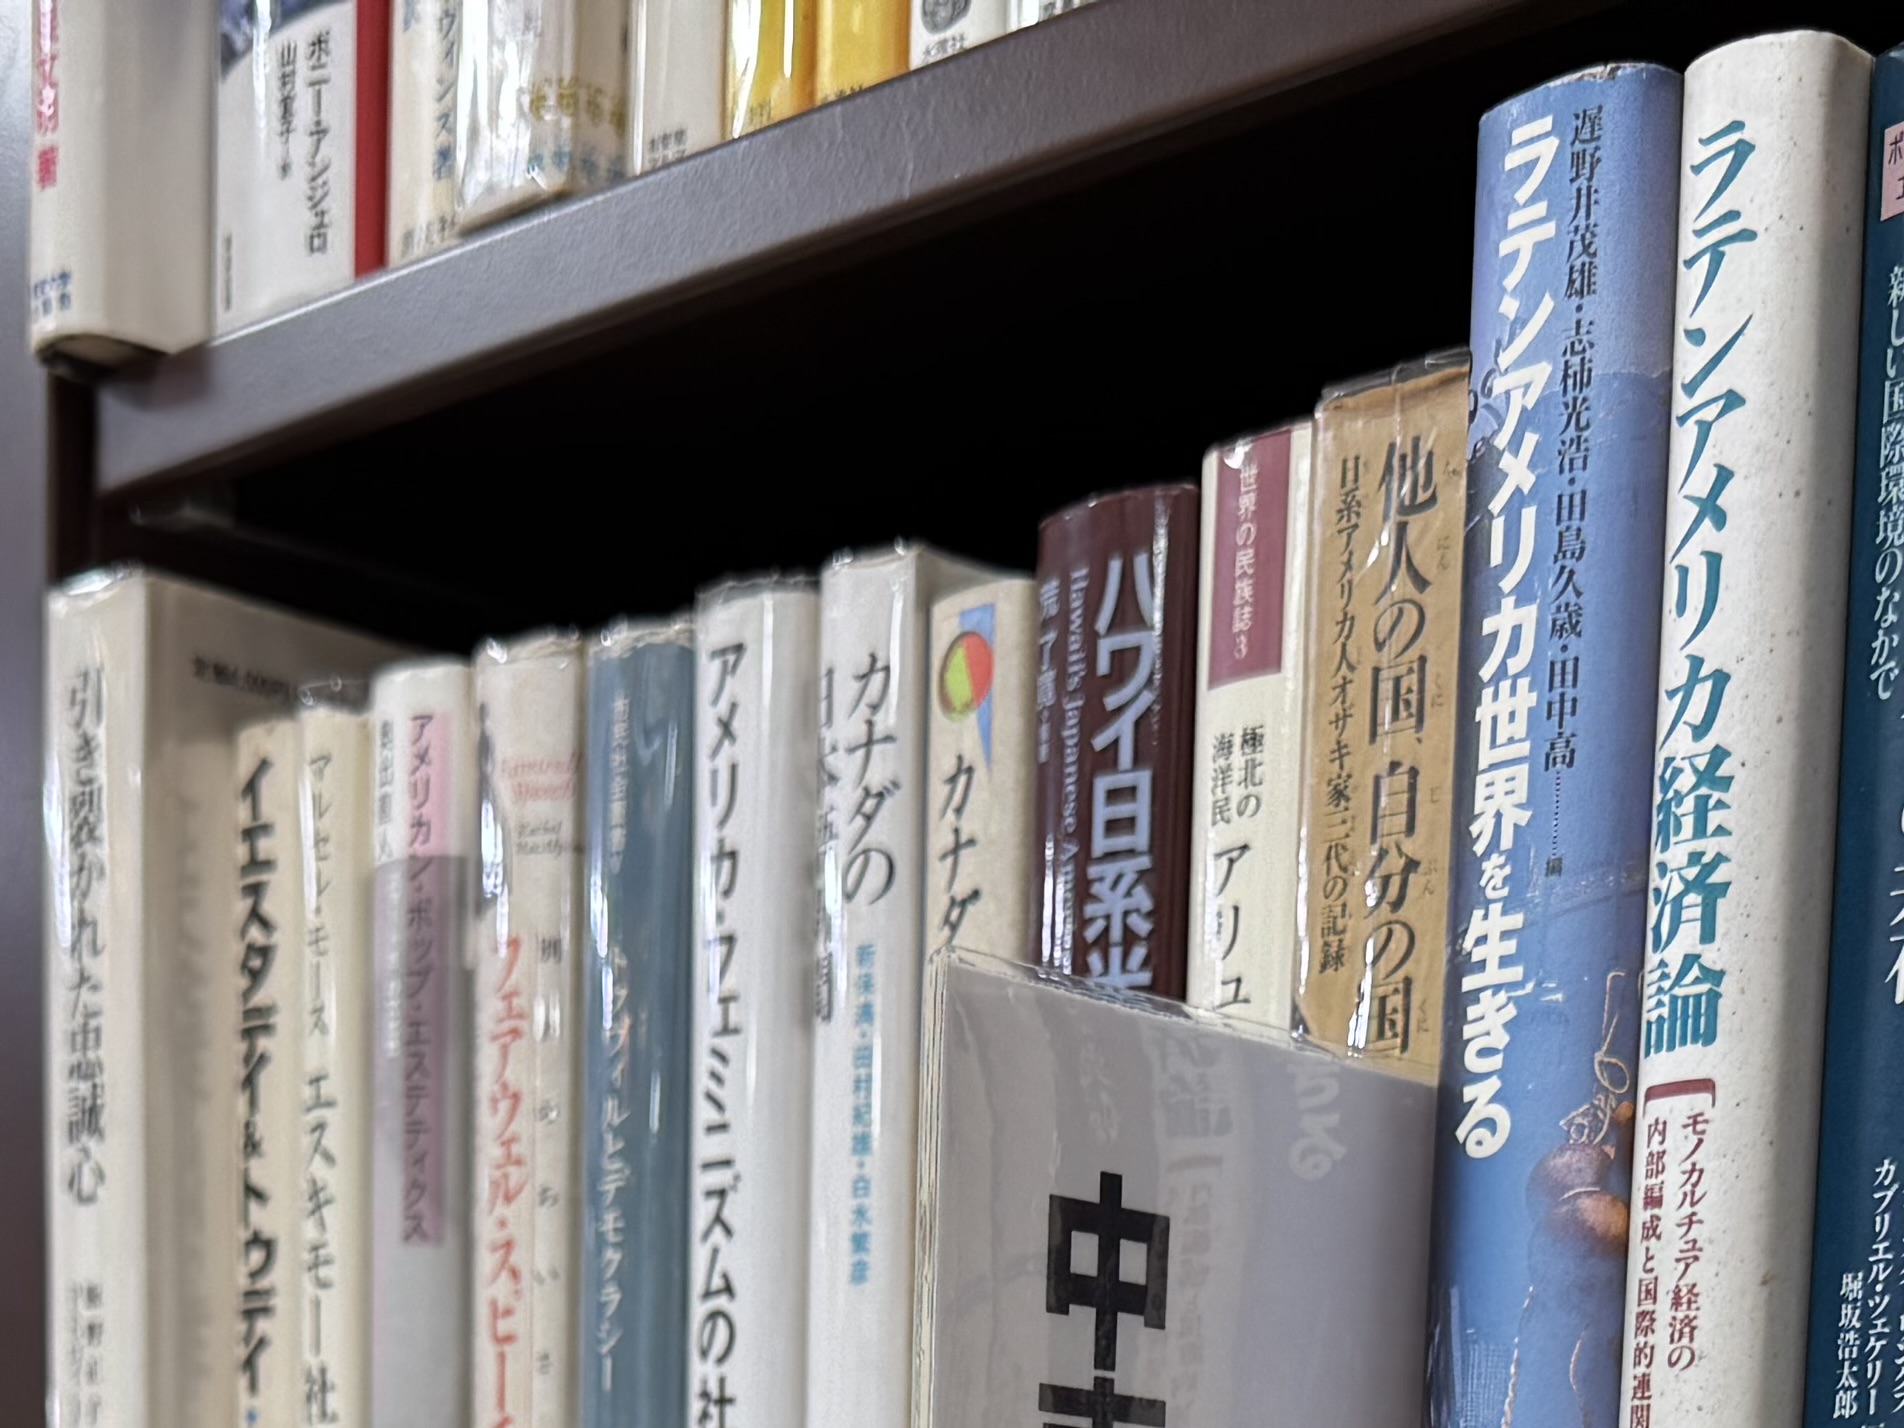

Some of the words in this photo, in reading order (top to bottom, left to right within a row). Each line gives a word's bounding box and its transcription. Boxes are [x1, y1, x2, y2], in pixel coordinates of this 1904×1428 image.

[846, 650, 900, 907] カナダの
[1210, 734, 1235, 828] 海洋民
[1235, 722, 1266, 821] 極北の
[1318, 455, 1363, 974] 日系アメリカ人オザキ家三代の記録
[1366, 433, 1440, 1058] 他人の国、自分の国
[1453, 112, 1562, 1160] ラテンアメリカ世界を生きる
[1642, 117, 1759, 1060] ラテンアメリカ経済論
[66, 667, 107, 1206] 引き裂かれた忠誠心
[400, 713, 437, 1246] アメリカン・ポップ・エステティクス
[937, 754, 984, 951] カナダ
[1665, 1110, 1711, 1371] モノカルチュア経済の
[1832, 1270, 1865, 1420] 堀坂浩太郎
